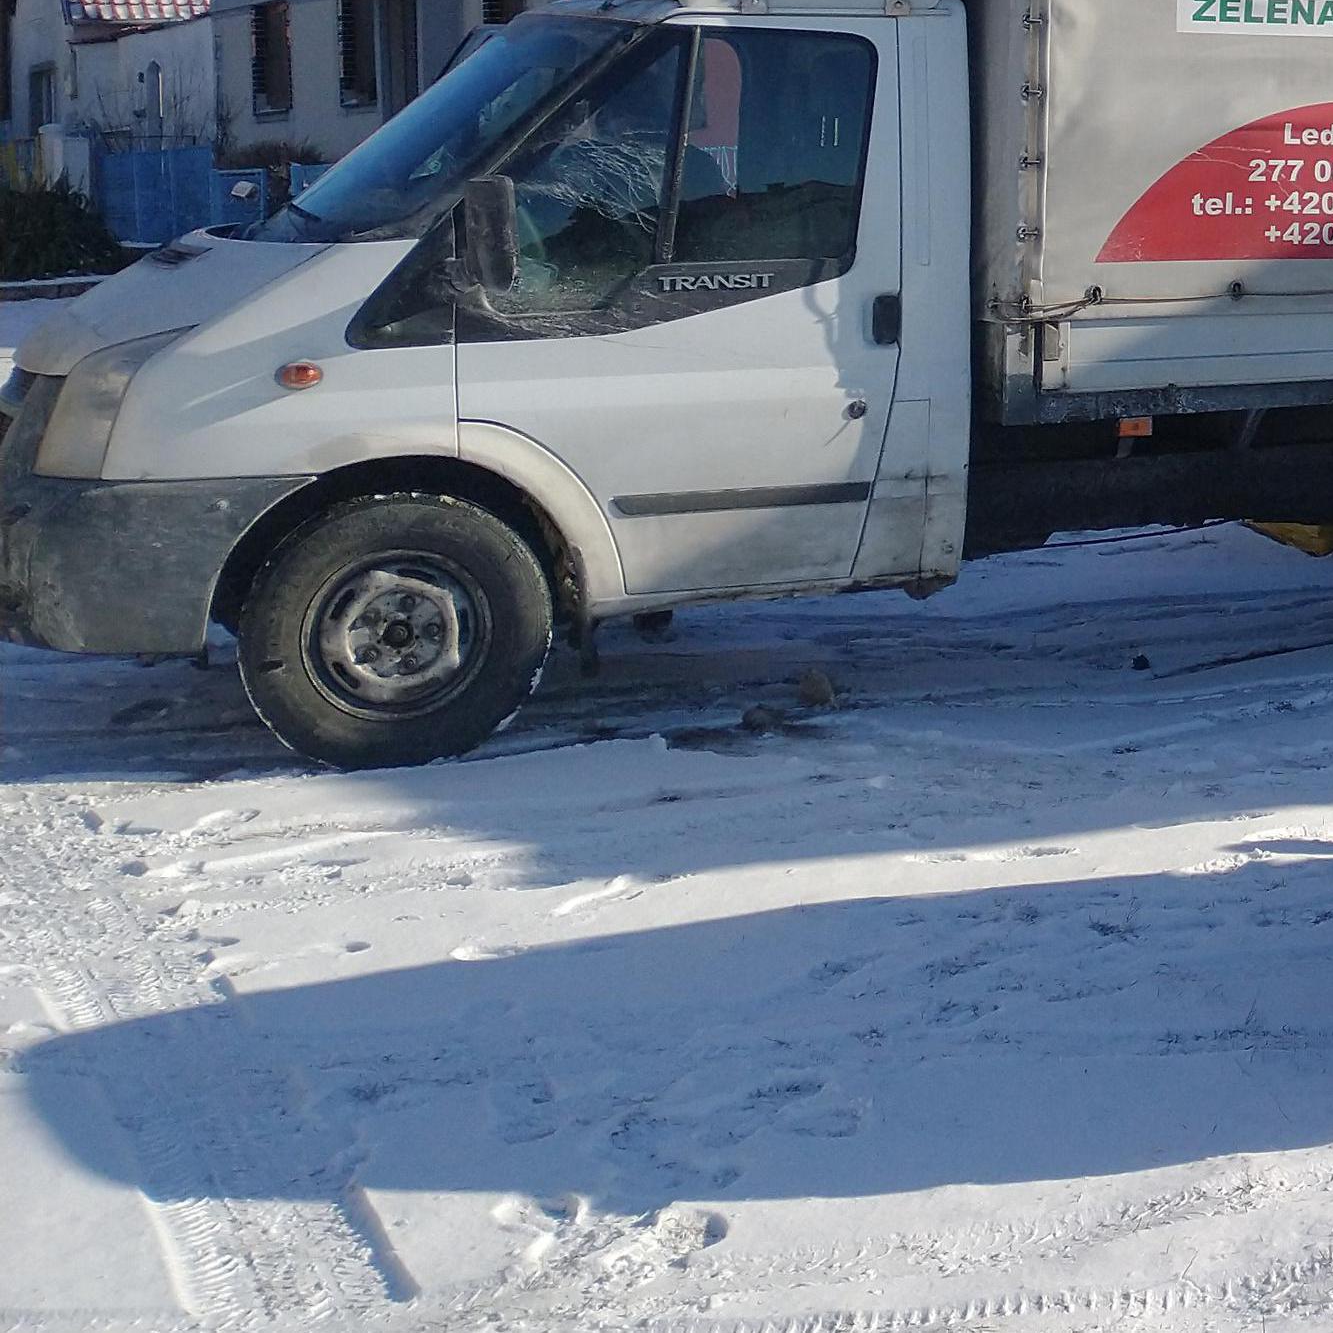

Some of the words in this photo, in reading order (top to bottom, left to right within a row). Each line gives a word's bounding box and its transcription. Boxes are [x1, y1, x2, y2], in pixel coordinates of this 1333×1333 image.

[1248, 159, 1304, 183] 277
[1191, 192, 1254, 216] tel.:
[658, 272, 775, 292] TRANSIT
